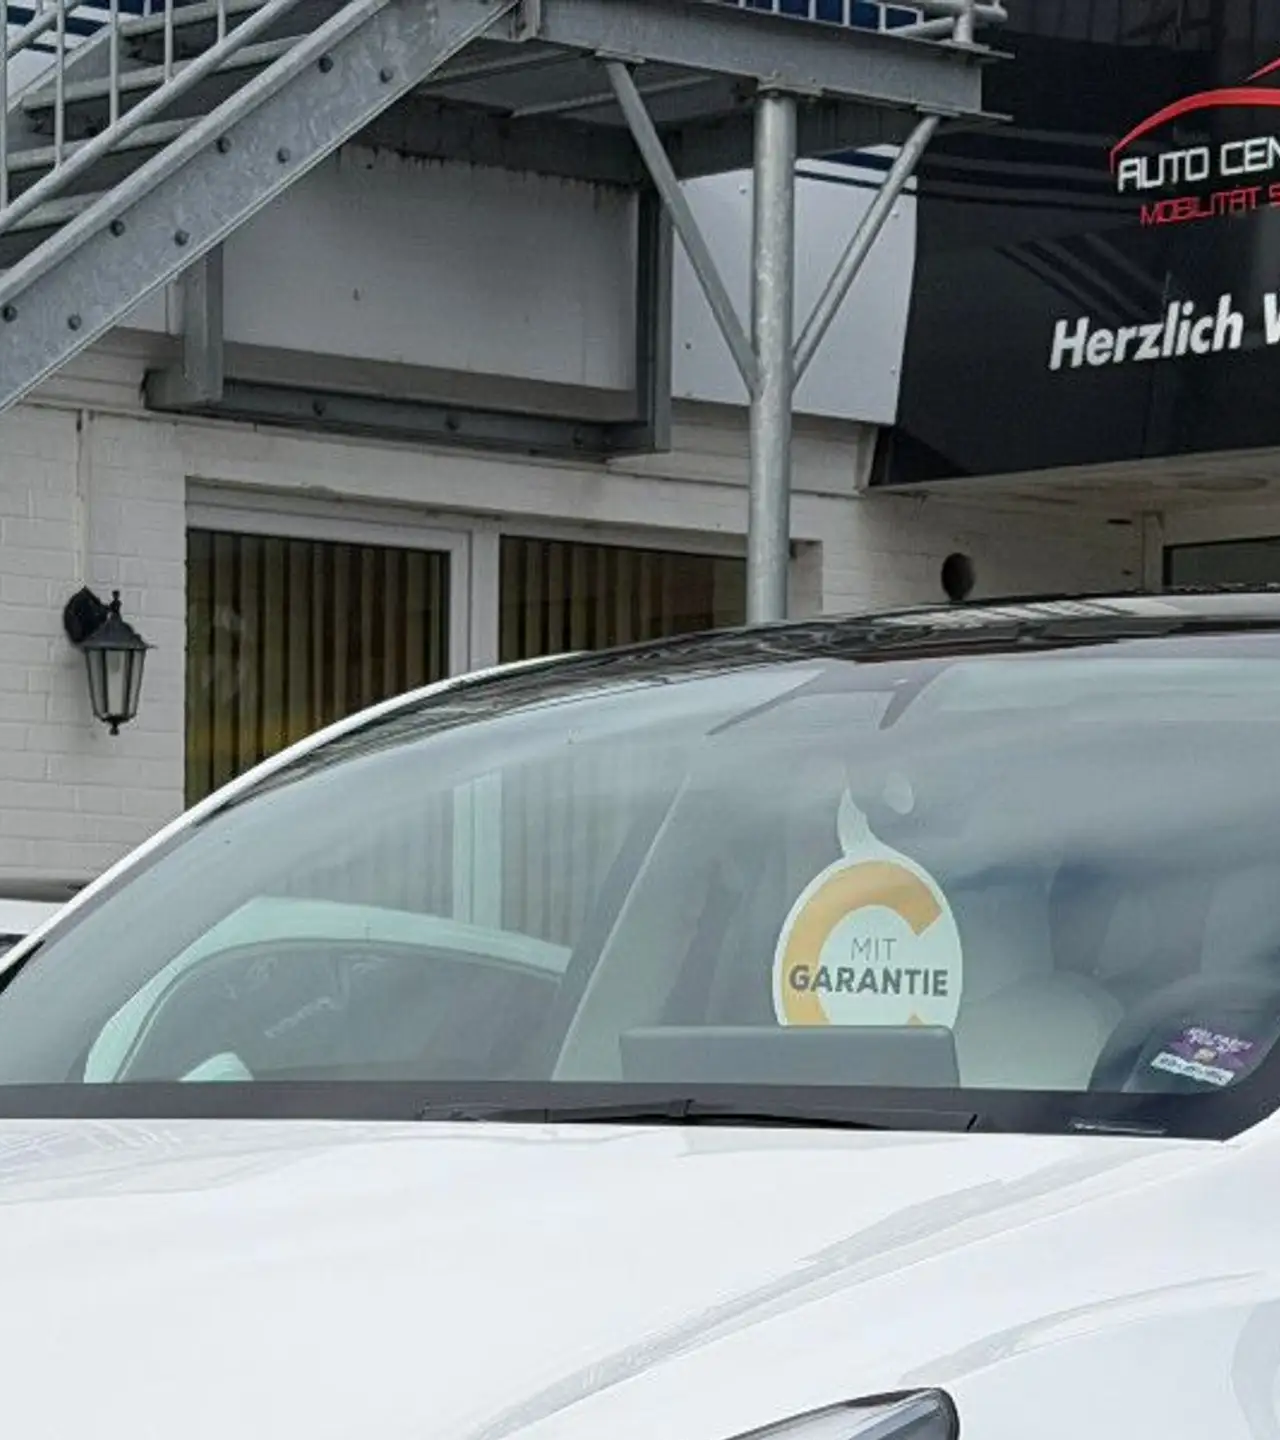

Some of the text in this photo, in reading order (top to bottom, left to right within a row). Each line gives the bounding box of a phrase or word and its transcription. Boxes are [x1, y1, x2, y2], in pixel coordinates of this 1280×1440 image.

[1118, 146, 1210, 192] AUTO
[1048, 293, 1244, 371] Herzlich
[851, 938, 897, 961] MIT
[789, 965, 949, 997] GARANTIE
